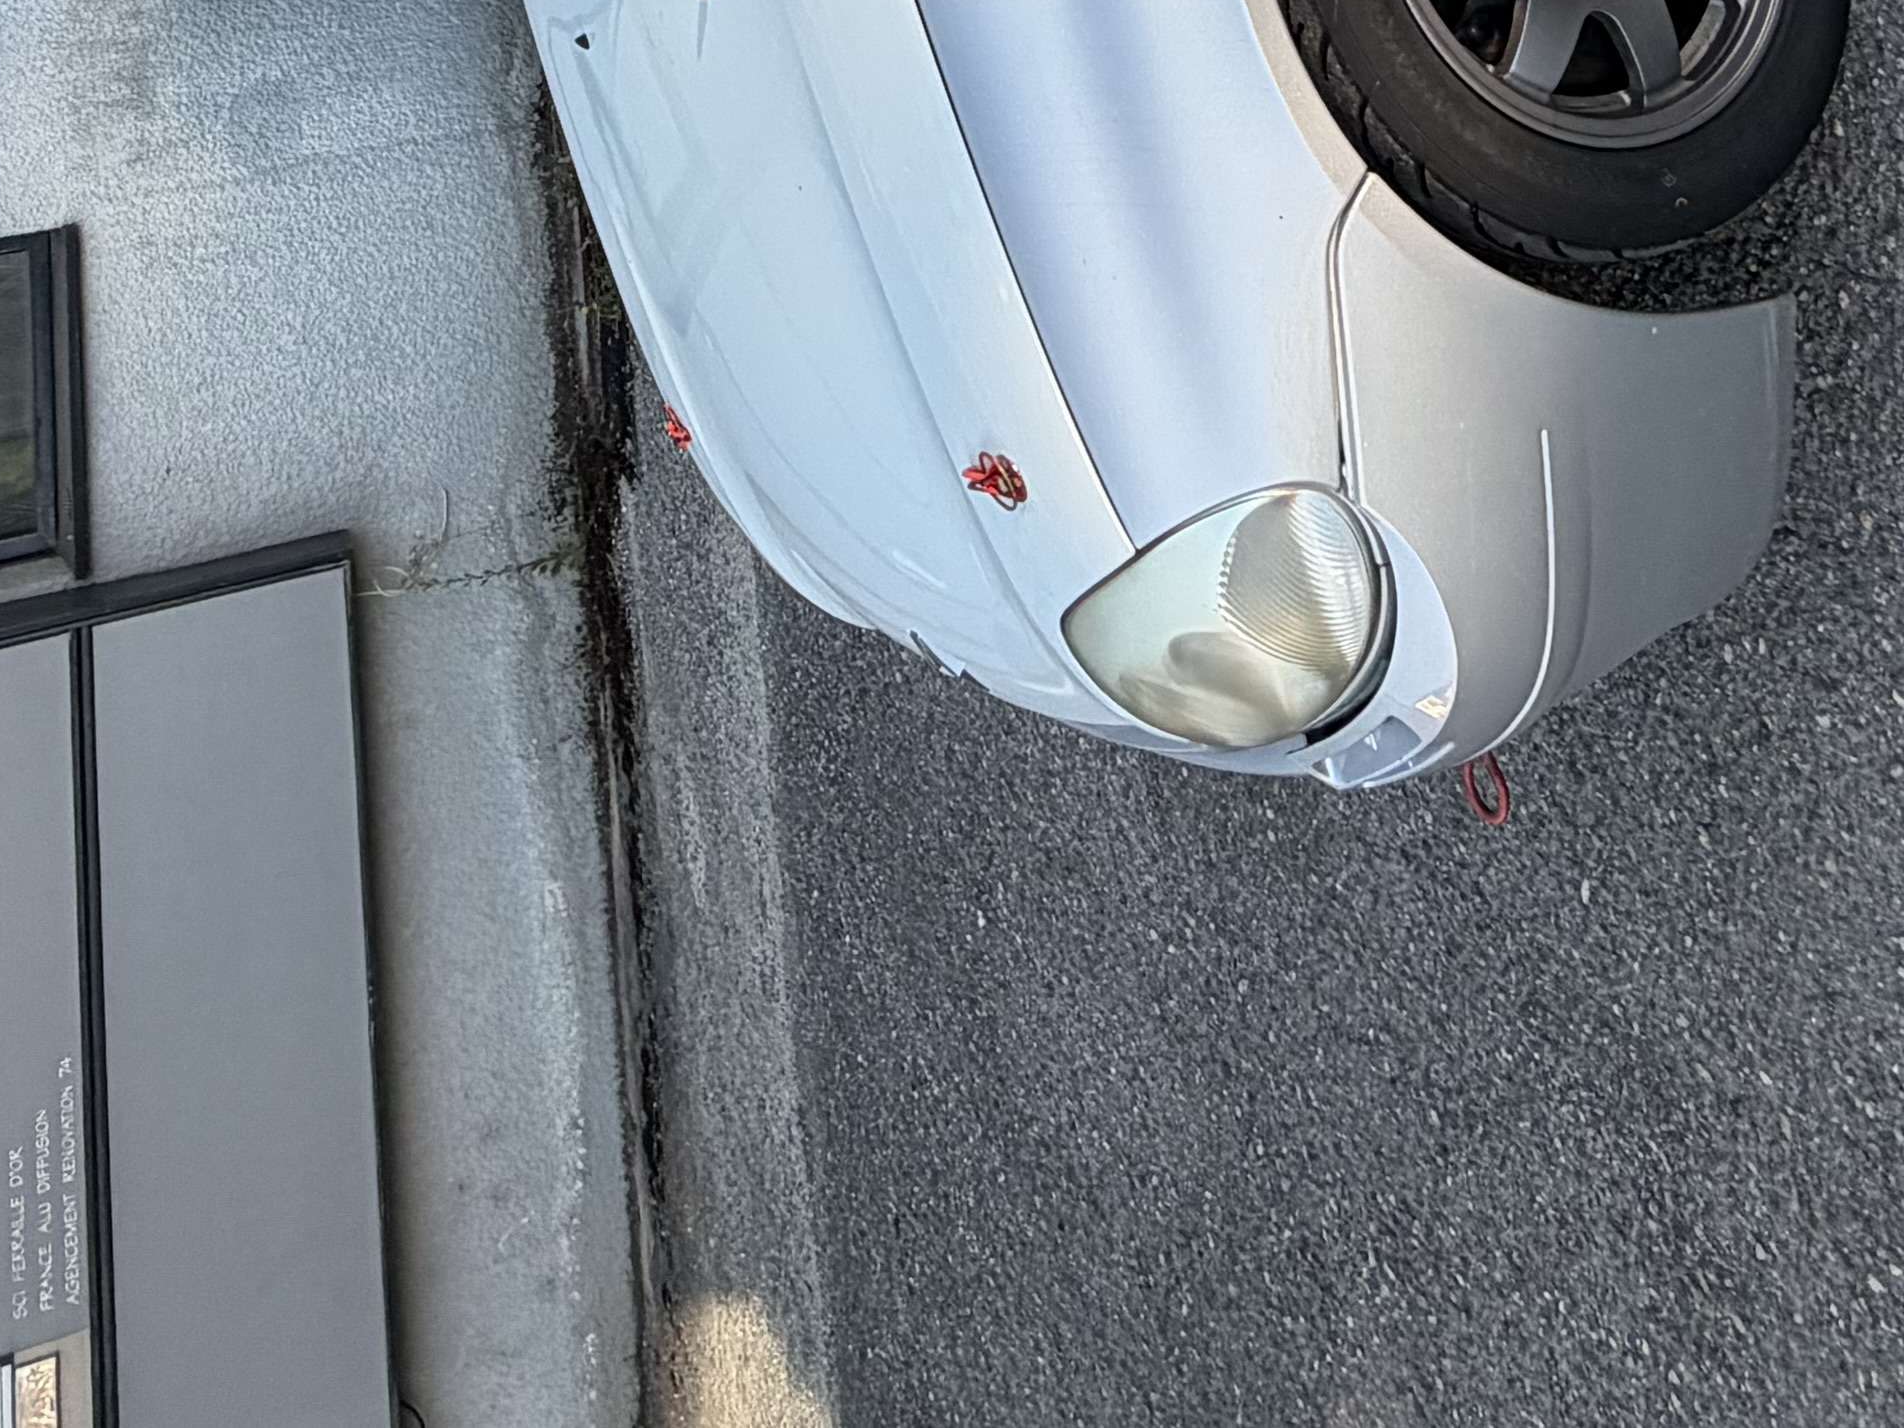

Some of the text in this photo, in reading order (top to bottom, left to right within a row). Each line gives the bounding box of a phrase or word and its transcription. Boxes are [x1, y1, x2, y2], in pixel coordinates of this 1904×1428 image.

[34, 1109, 55, 1312] FRANCE ALU DIFFUSION
[57, 1057, 81, 1305] AGENCEMENT RENOVATION 74
